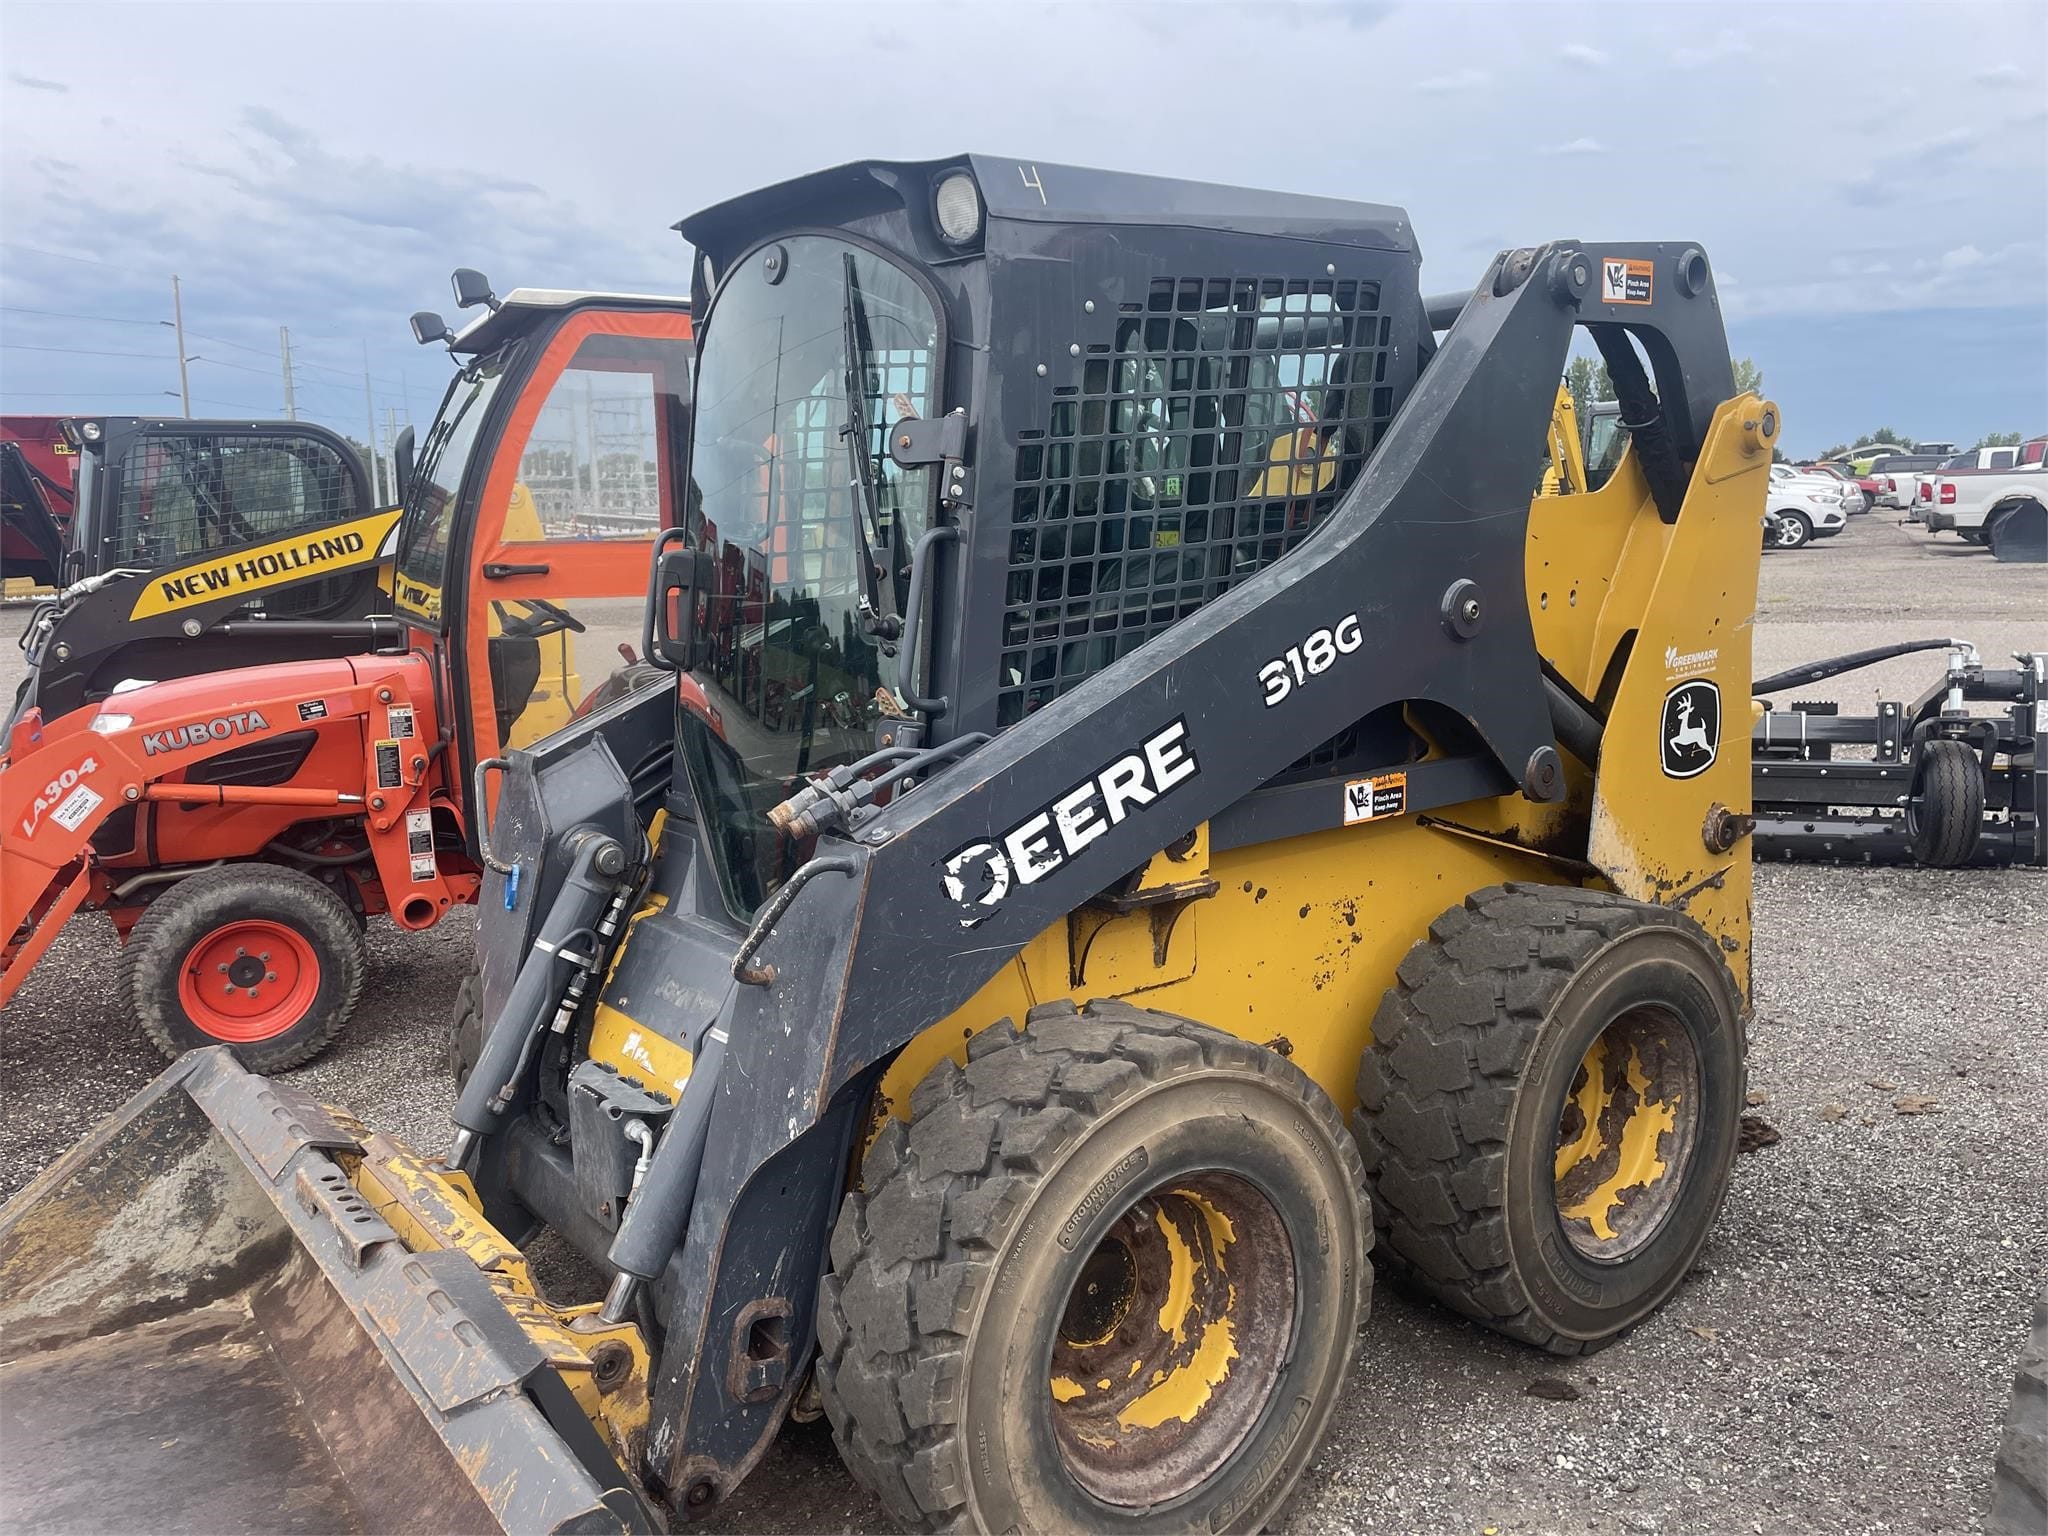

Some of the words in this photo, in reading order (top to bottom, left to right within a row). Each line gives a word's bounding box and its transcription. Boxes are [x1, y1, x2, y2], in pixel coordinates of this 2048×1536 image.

[1018, 165, 1047, 206] 4
[161, 566, 231, 602] NEW
[235, 532, 364, 582] HOLLAND
[1258, 613, 1363, 708] 318G
[1672, 648, 1719, 668] GREENMARK
[141, 710, 271, 757] KUBOTA
[22, 757, 99, 838] LA304
[943, 721, 1196, 927] DEERE
[1374, 793, 1390, 803] Pinch
[1390, 792, 1402, 800] Area
[1066, 1154, 1137, 1233] GROUNDFORCE
